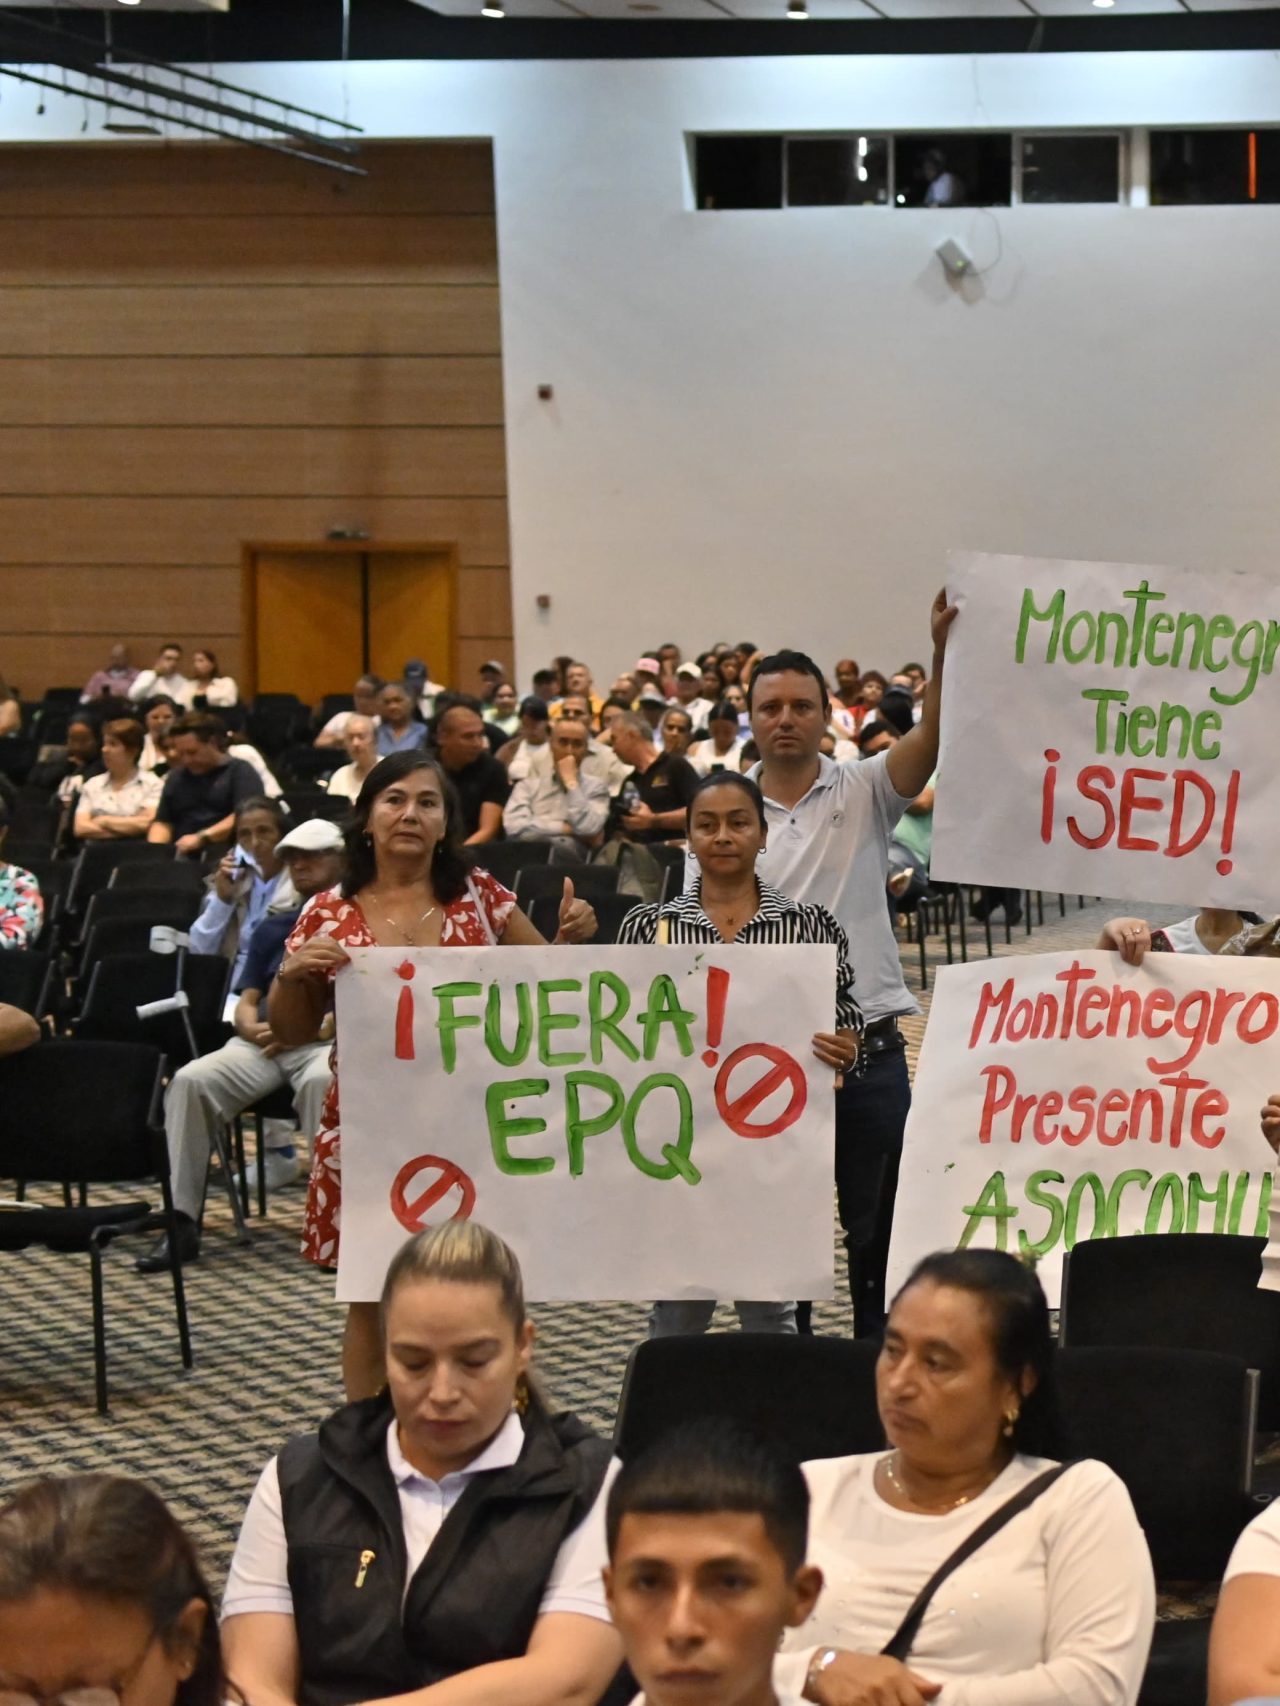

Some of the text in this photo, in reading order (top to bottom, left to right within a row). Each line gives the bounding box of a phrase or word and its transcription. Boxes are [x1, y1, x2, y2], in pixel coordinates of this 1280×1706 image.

[1081, 687, 1223, 761] Tiene
[1040, 748, 1241, 876] ¡SED!
[394, 959, 731, 1074] ¡FUERA!
[968, 960, 1280, 1075] Montenegro
[485, 1070, 701, 1186] EPQ
[978, 1064, 1229, 1149] Presente
